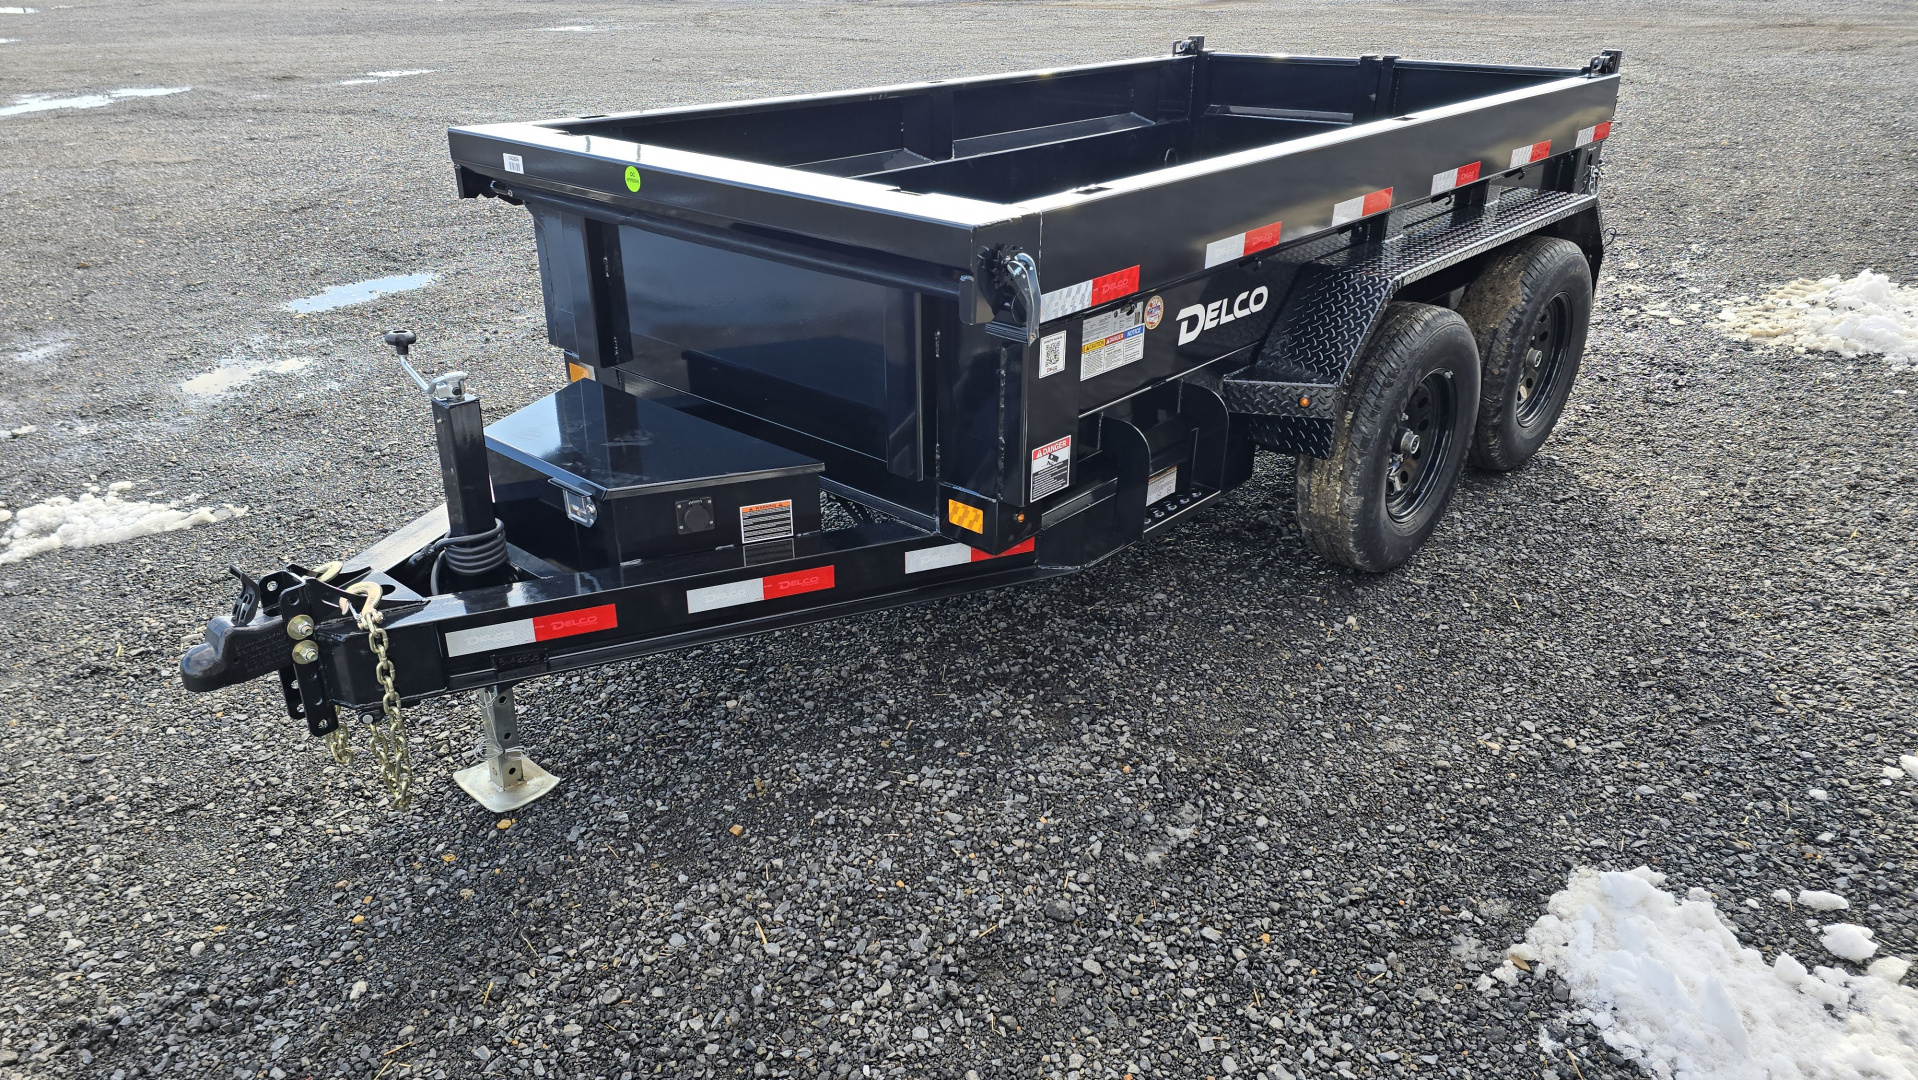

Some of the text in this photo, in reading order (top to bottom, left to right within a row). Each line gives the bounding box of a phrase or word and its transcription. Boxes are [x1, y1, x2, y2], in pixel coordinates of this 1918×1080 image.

[1101, 278, 1129, 294] DELCO
[1176, 285, 1269, 347] DELCO
[1126, 327, 1142, 337] NOTICE
[1042, 439, 1067, 456] DANGER
[778, 576, 819, 590] DELCO
[551, 616, 598, 631] DELCO
